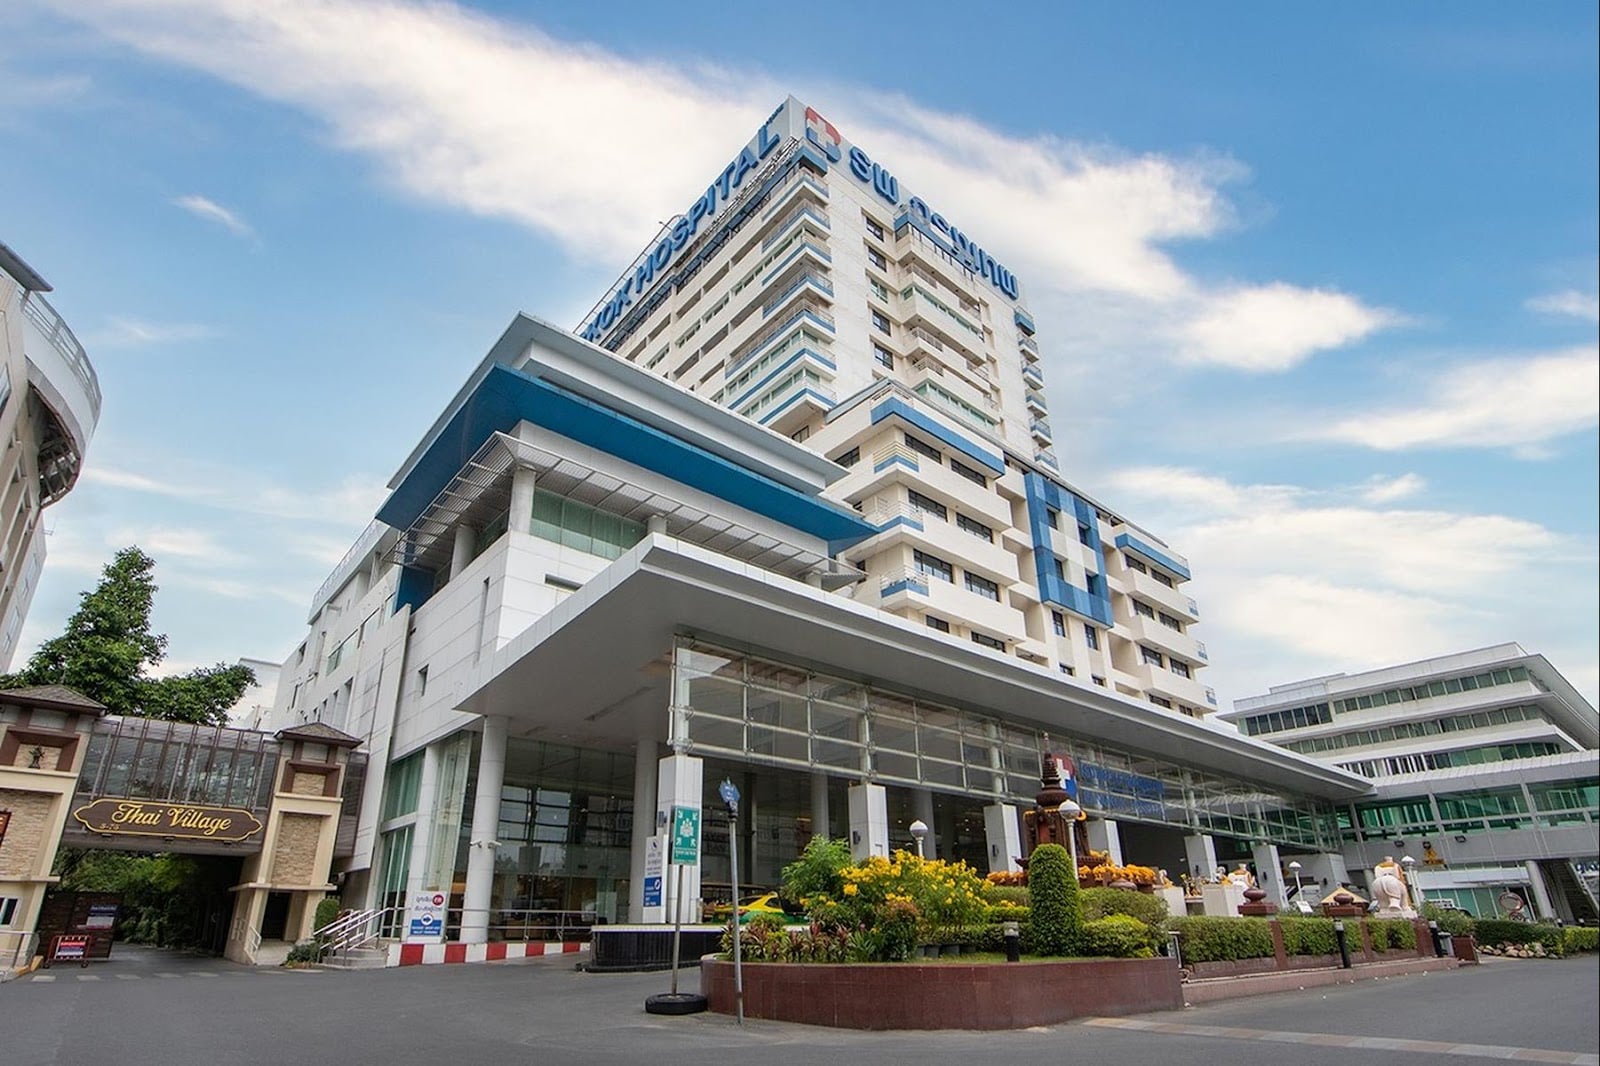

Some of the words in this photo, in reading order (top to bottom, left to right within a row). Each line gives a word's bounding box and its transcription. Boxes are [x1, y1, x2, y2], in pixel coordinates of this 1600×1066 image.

[580, 277, 632, 342] KOK
[636, 124, 781, 294] HOSPITAL
[910, 196, 1019, 301] กรงเทพ
[111, 803, 163, 825] Thai
[167, 806, 232, 836] Village
